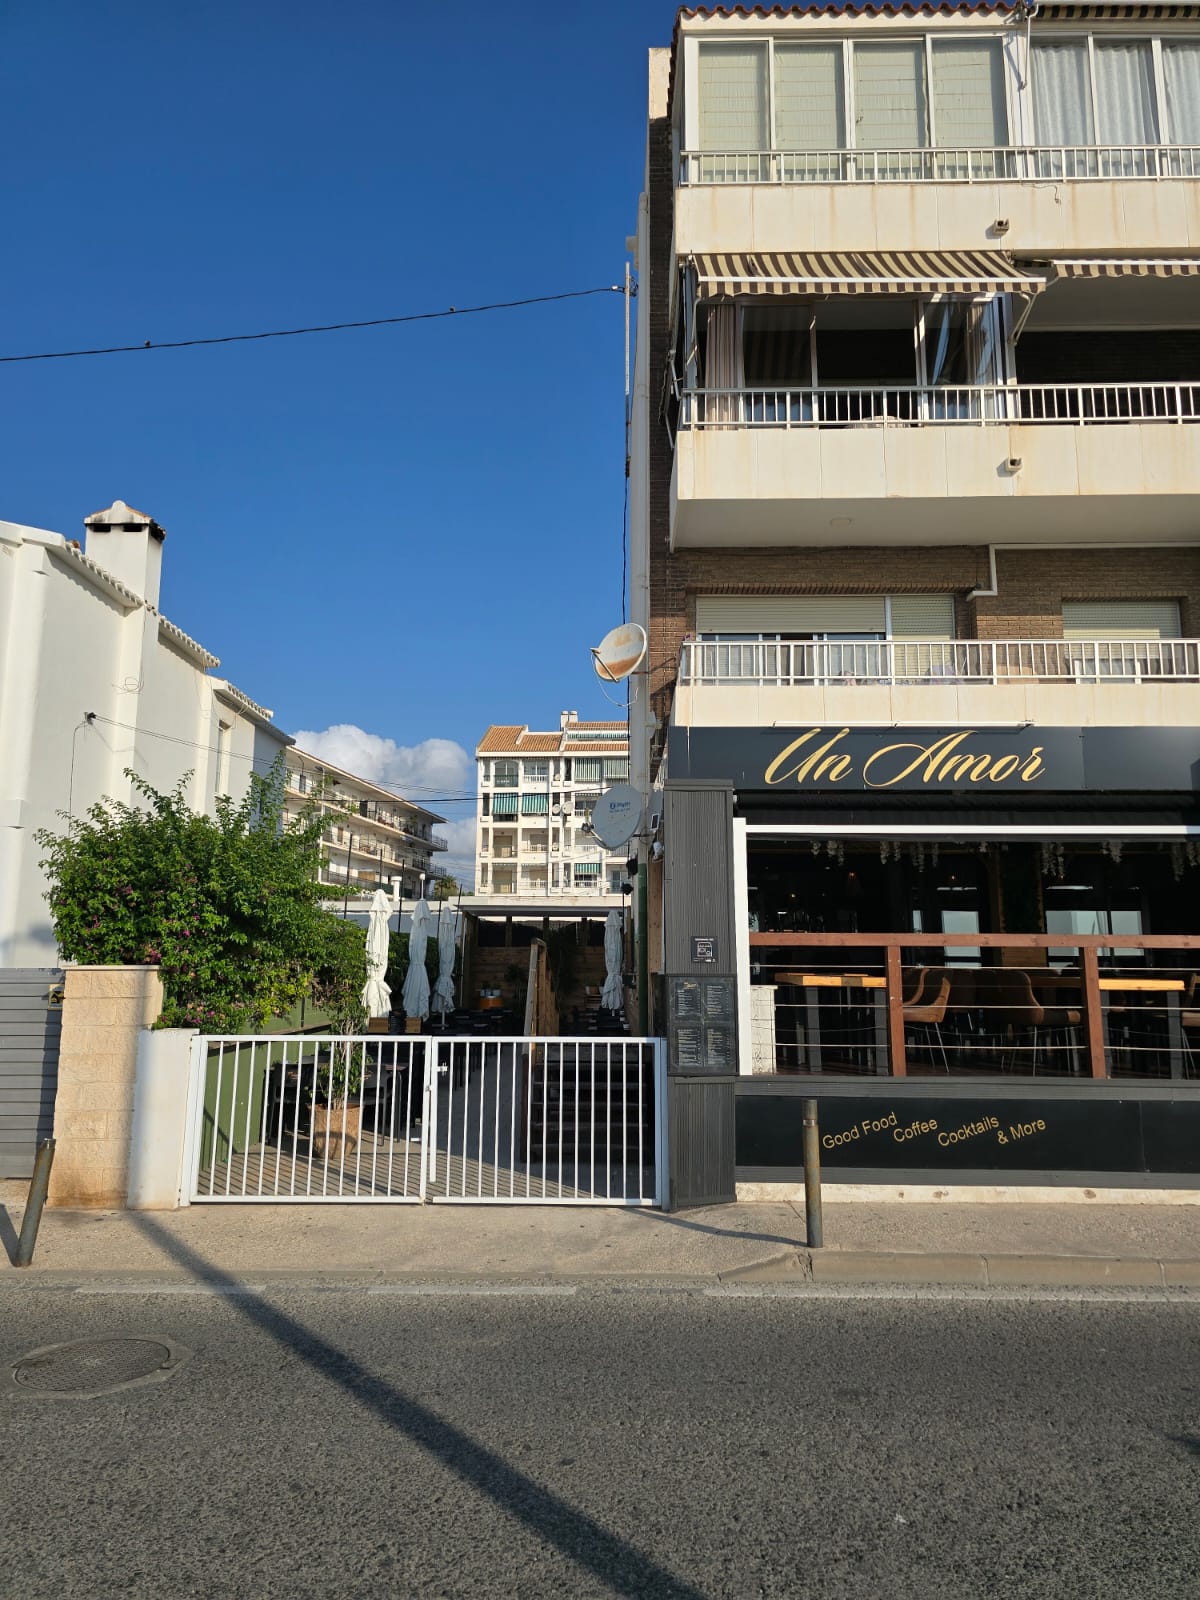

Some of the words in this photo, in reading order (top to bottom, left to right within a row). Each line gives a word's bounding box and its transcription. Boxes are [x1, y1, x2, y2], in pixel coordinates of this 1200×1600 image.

[764, 728, 853, 784] Un
[862, 730, 1045, 787] Amor
[822, 1126, 859, 1149] Good
[861, 1112, 898, 1135] Food
[893, 1117, 938, 1143] Coffee
[937, 1116, 999, 1146] Cocktails
[997, 1131, 1009, 1144] &
[1010, 1119, 1046, 1141] More
